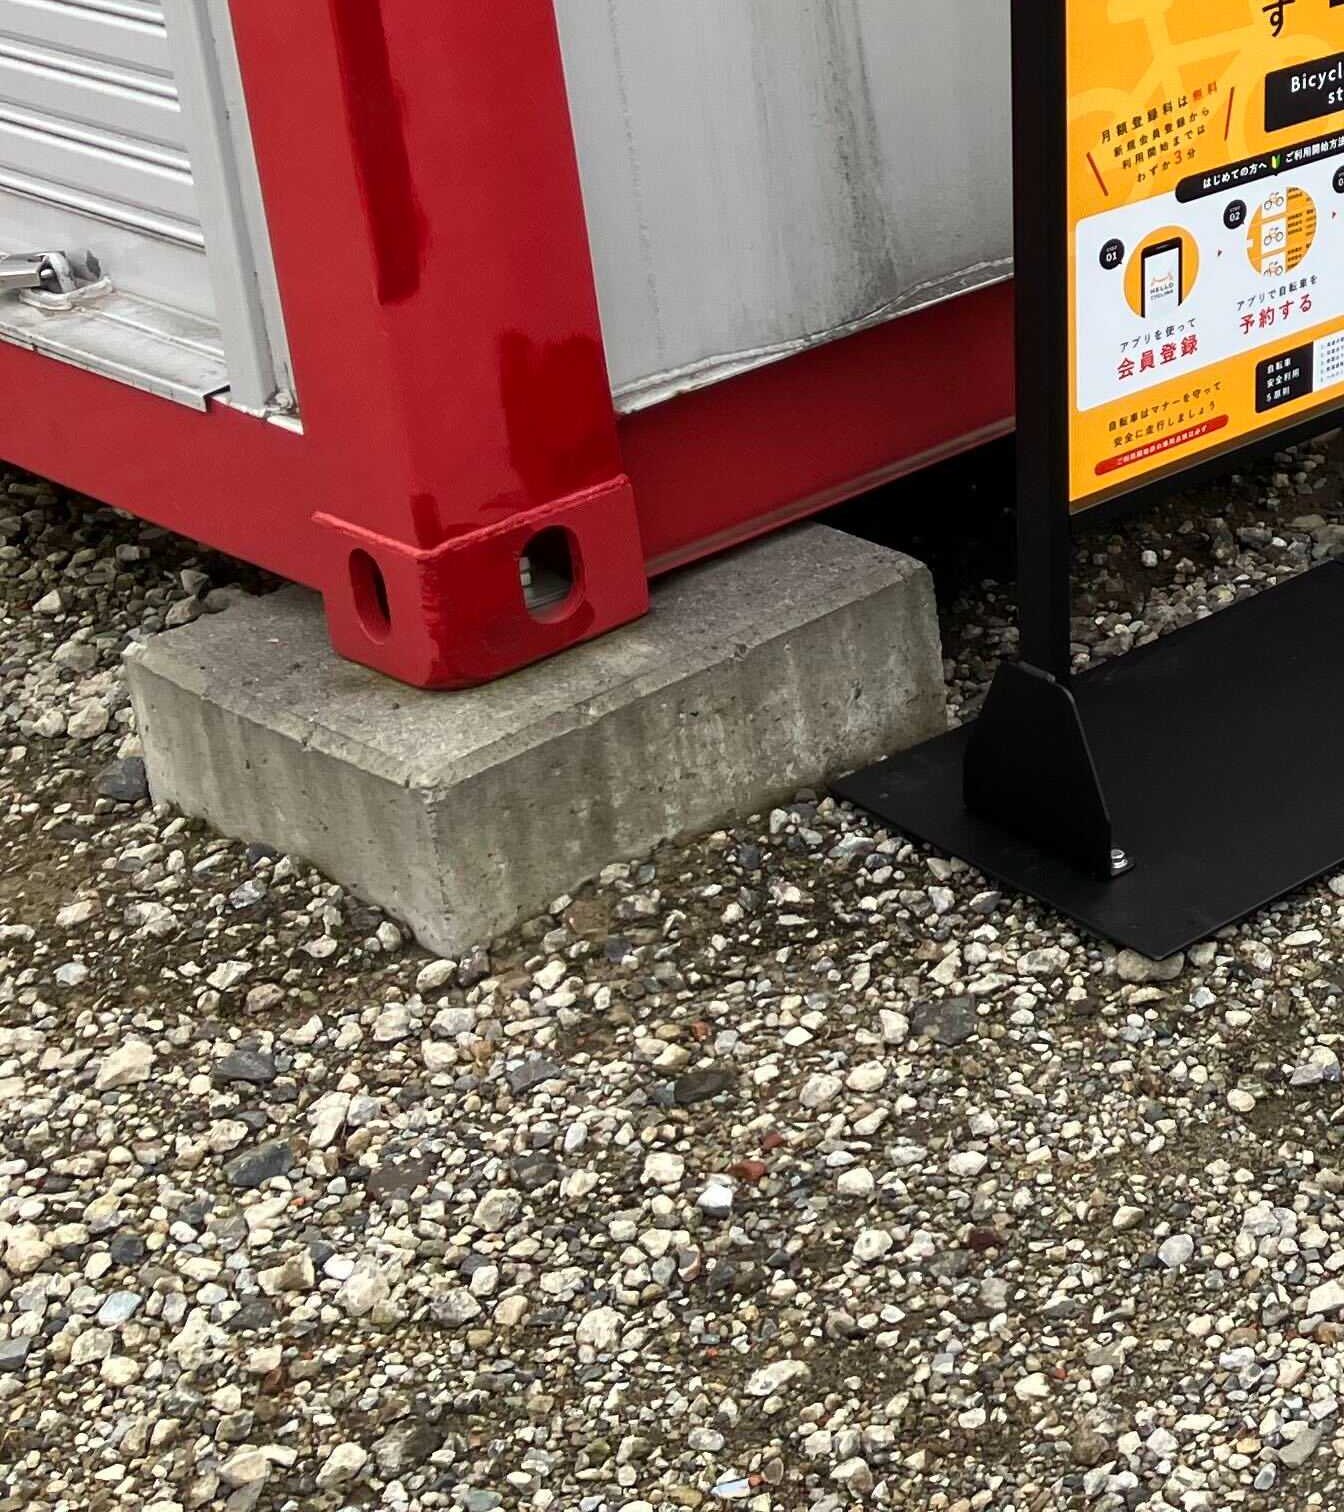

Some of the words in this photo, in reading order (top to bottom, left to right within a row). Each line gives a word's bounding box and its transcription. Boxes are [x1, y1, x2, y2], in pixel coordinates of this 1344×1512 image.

[1202, 162, 1268, 189] はじめての方へ
[1229, 211, 1240, 223] 02
[1105, 250, 1117, 263] 01
[1239, 293, 1313, 335] 予約する
[1117, 334, 1199, 381] 会員登録
